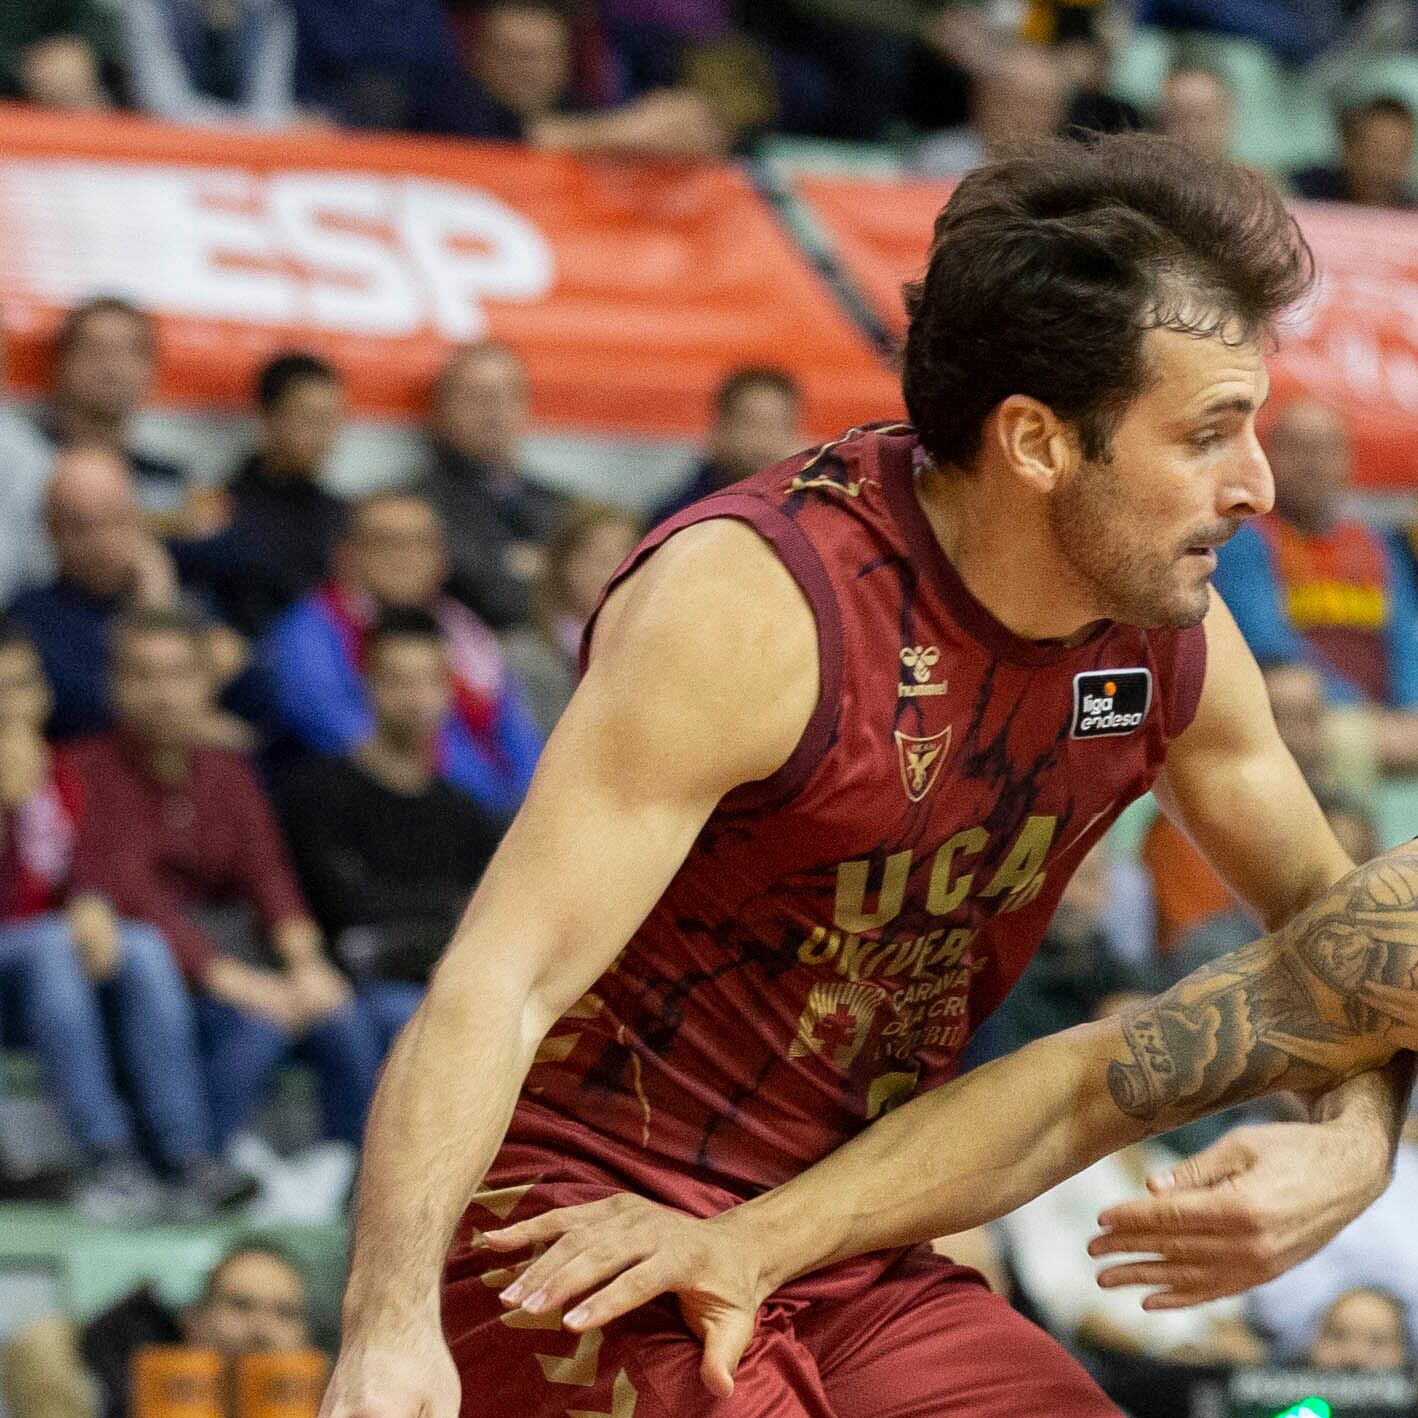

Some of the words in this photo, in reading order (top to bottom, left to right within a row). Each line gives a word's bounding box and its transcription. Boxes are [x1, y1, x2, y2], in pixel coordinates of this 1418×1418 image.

[1083, 694, 1113, 715] liga
[1081, 711, 1142, 731] endesa
[833, 815, 1057, 935] UCA
